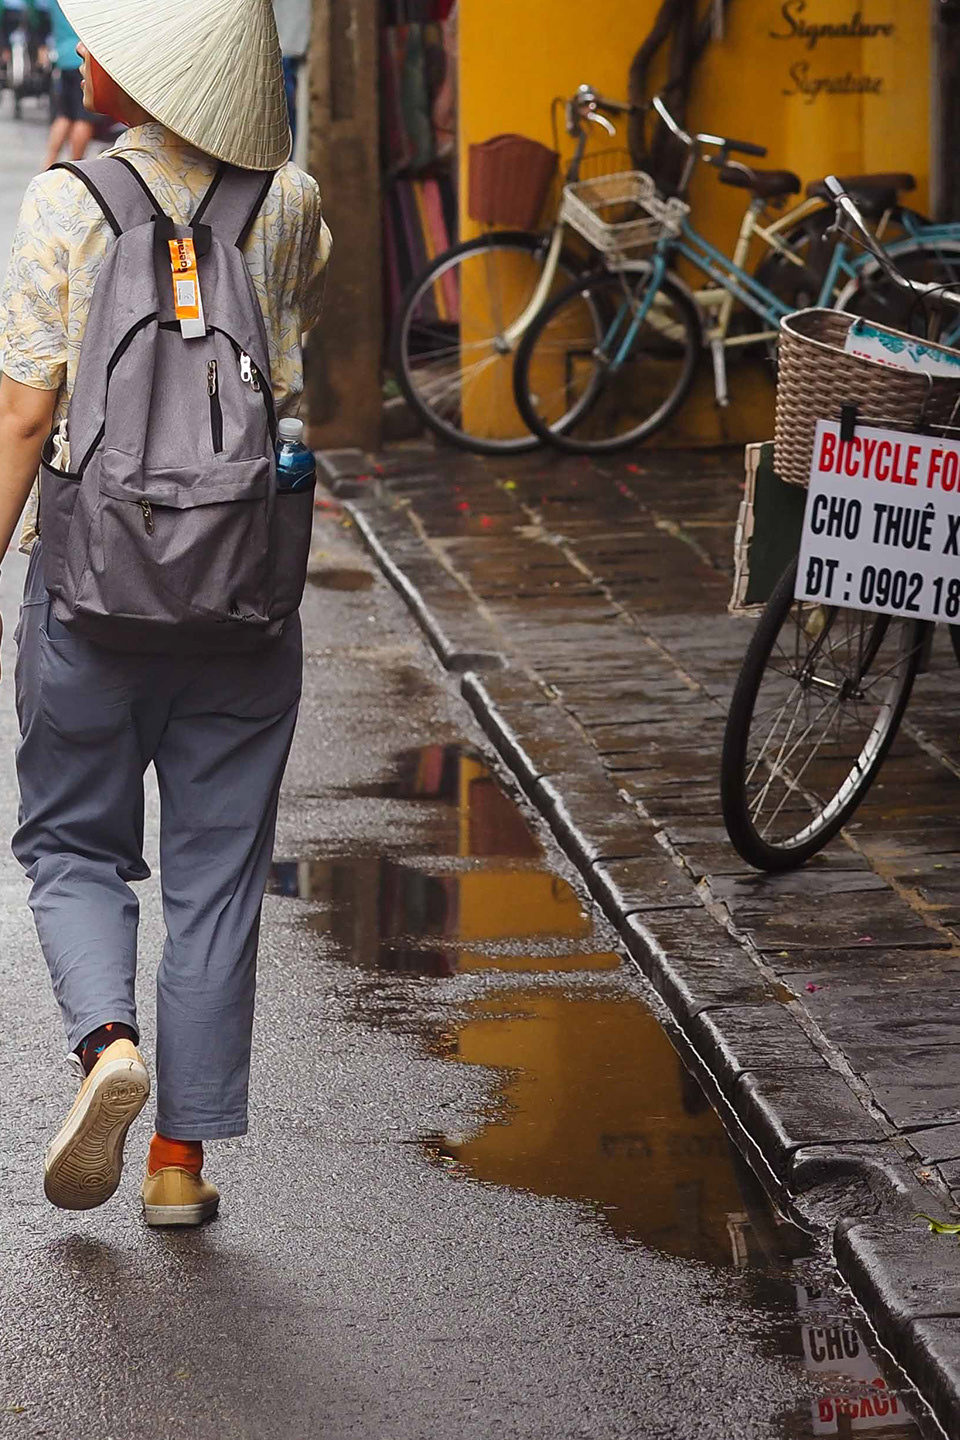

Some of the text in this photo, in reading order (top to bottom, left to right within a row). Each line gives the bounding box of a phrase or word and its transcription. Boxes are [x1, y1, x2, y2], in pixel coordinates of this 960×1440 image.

[782, 61, 883, 105] Signature
[818, 432, 960, 493] BICYCLE FO
[810, 494, 862, 540] CHO
[873, 502, 936, 551] THUÊ
[805, 556, 839, 598] ĐT
[859, 565, 924, 611] 0902
